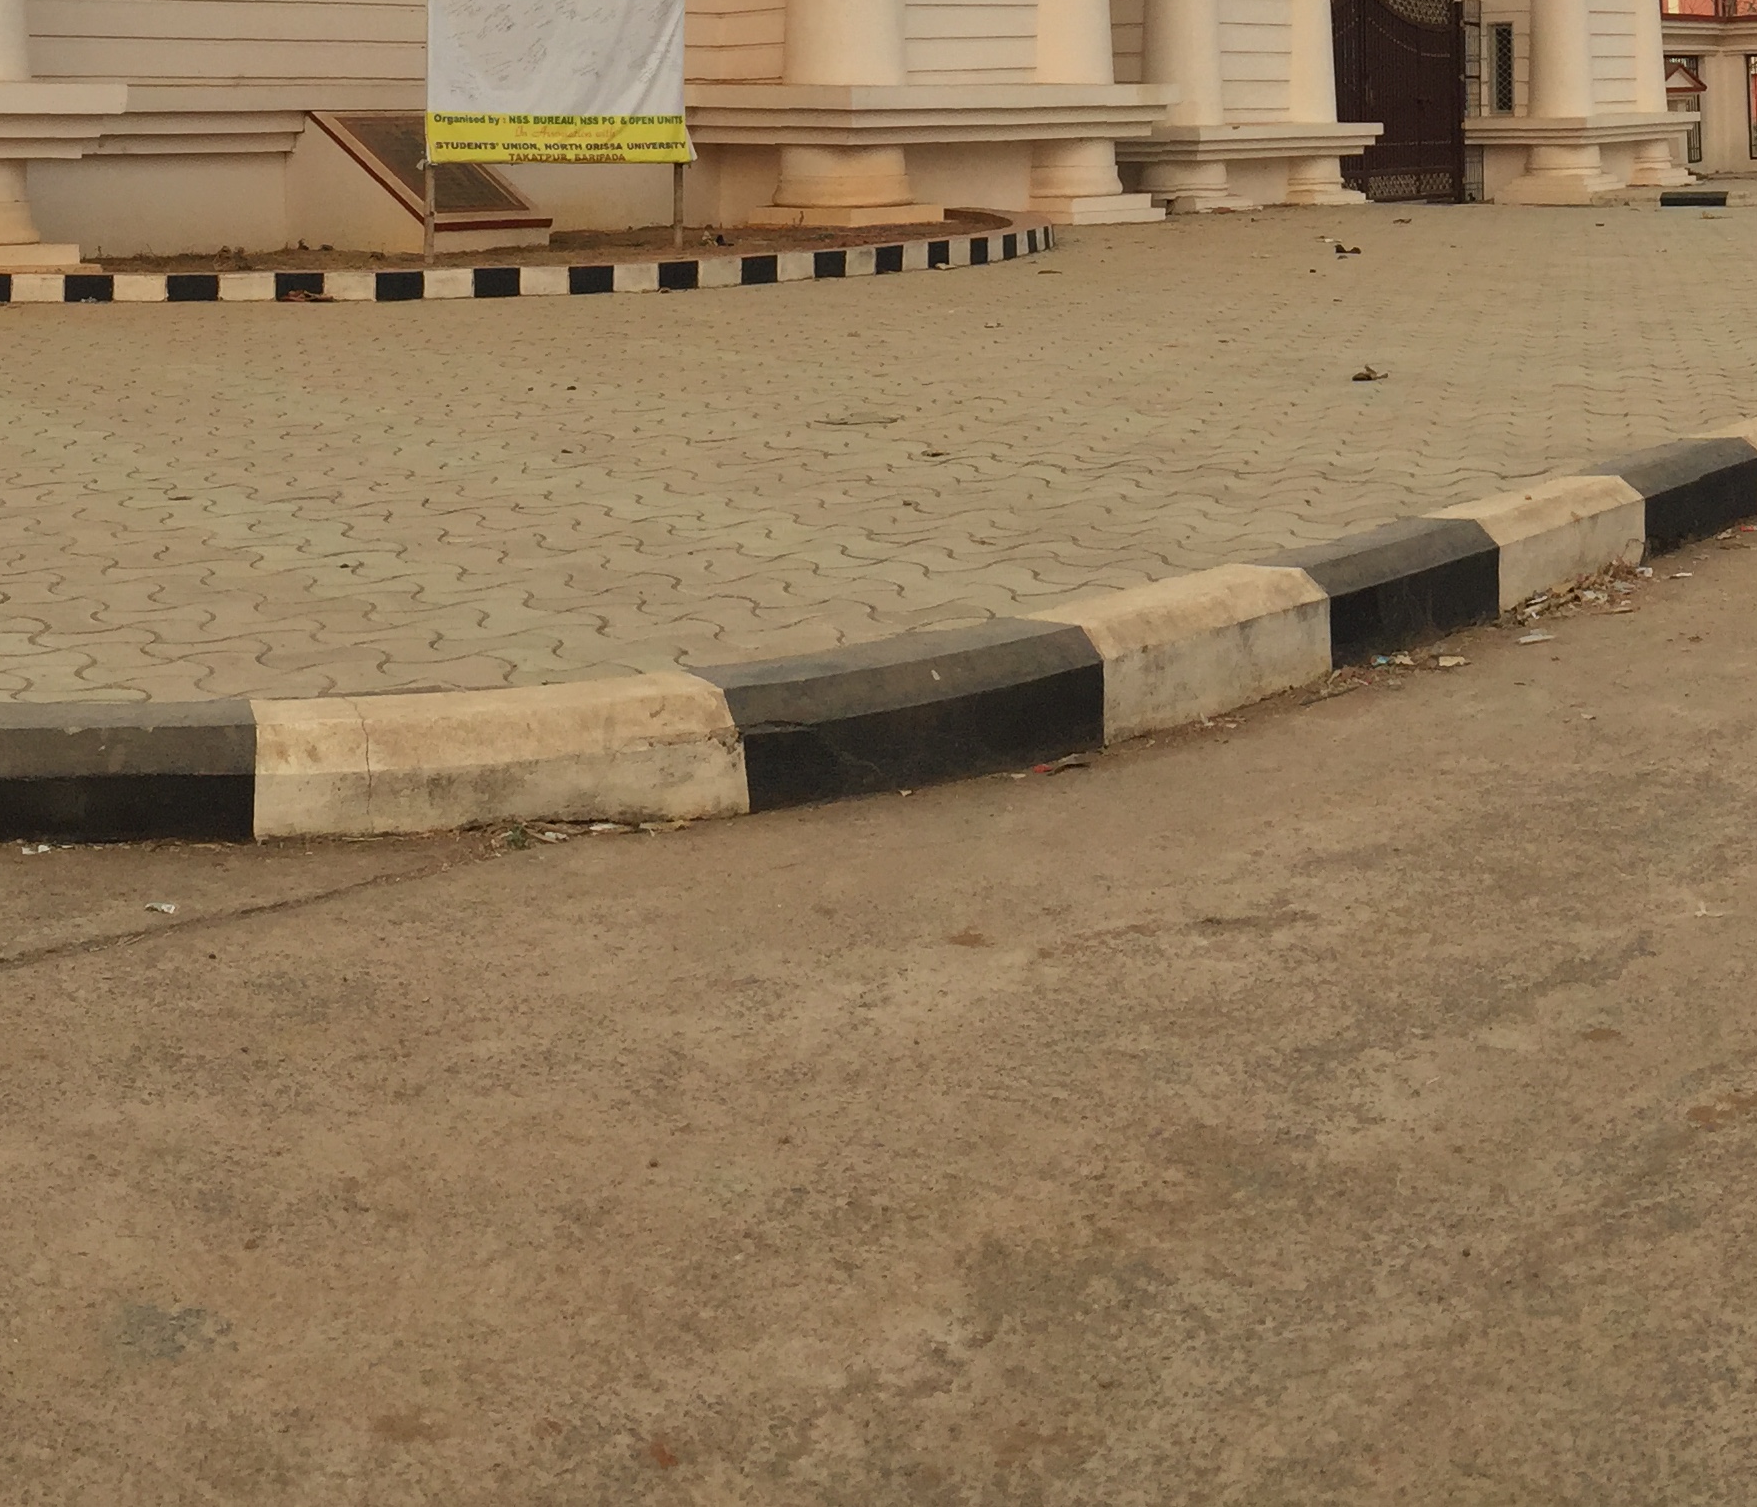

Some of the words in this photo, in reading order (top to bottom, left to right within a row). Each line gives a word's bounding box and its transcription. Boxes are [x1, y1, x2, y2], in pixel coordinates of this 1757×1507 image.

[434, 114, 486, 125] Organised
[488, 116, 500, 125] by
[533, 116, 577, 126] BUREAU,
[580, 117, 599, 125] NSS
[629, 116, 655, 125] OPEN
[657, 116, 683, 124] UNITS
[544, 143, 583, 151] NORTH
[627, 141, 686, 150] UNIVERSITY
[574, 153, 626, 162] BARIPADA
